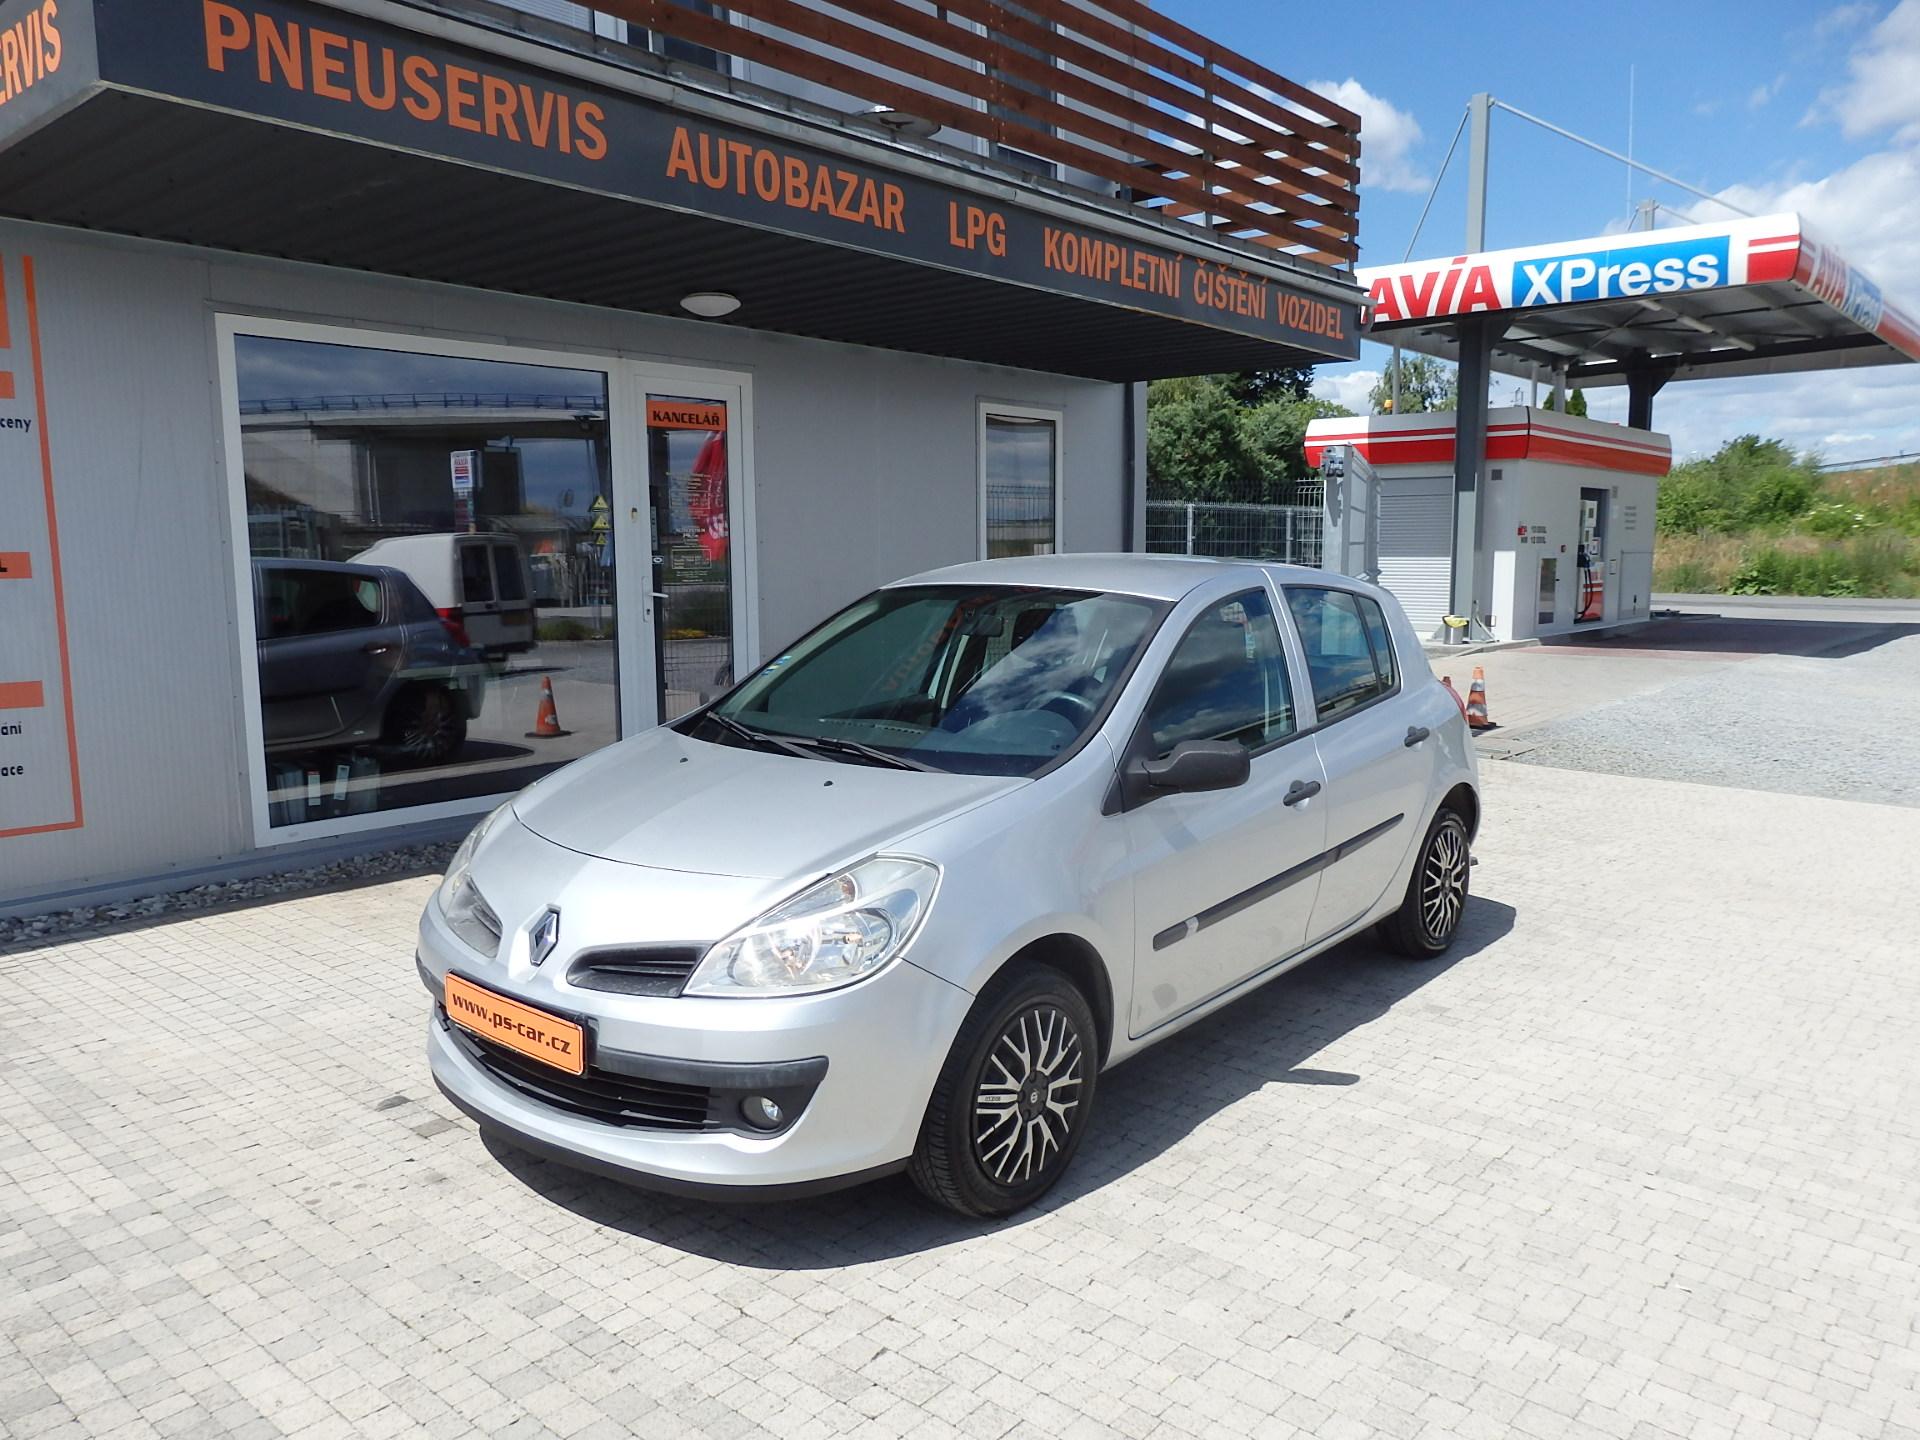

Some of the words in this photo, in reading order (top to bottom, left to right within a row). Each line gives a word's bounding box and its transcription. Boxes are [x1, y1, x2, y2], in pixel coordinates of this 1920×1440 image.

[0, 0, 61, 104] RVIS
[202, 0, 608, 161] PNEUSERVIS
[666, 127, 906, 233] AUTOBAZAR
[949, 202, 1006, 256] LPG
[1043, 226, 1184, 298] KOMPLETNÍ
[1193, 258, 1268, 320] ČIŠTĚNÍ
[1277, 291, 1344, 340] VOZIDEL
[1521, 254, 1720, 307] XPress
[0, 418, 31, 433] ceny
[1, 765, 24, 777] ace
[452, 993, 572, 1055] www.ps-car.cz
